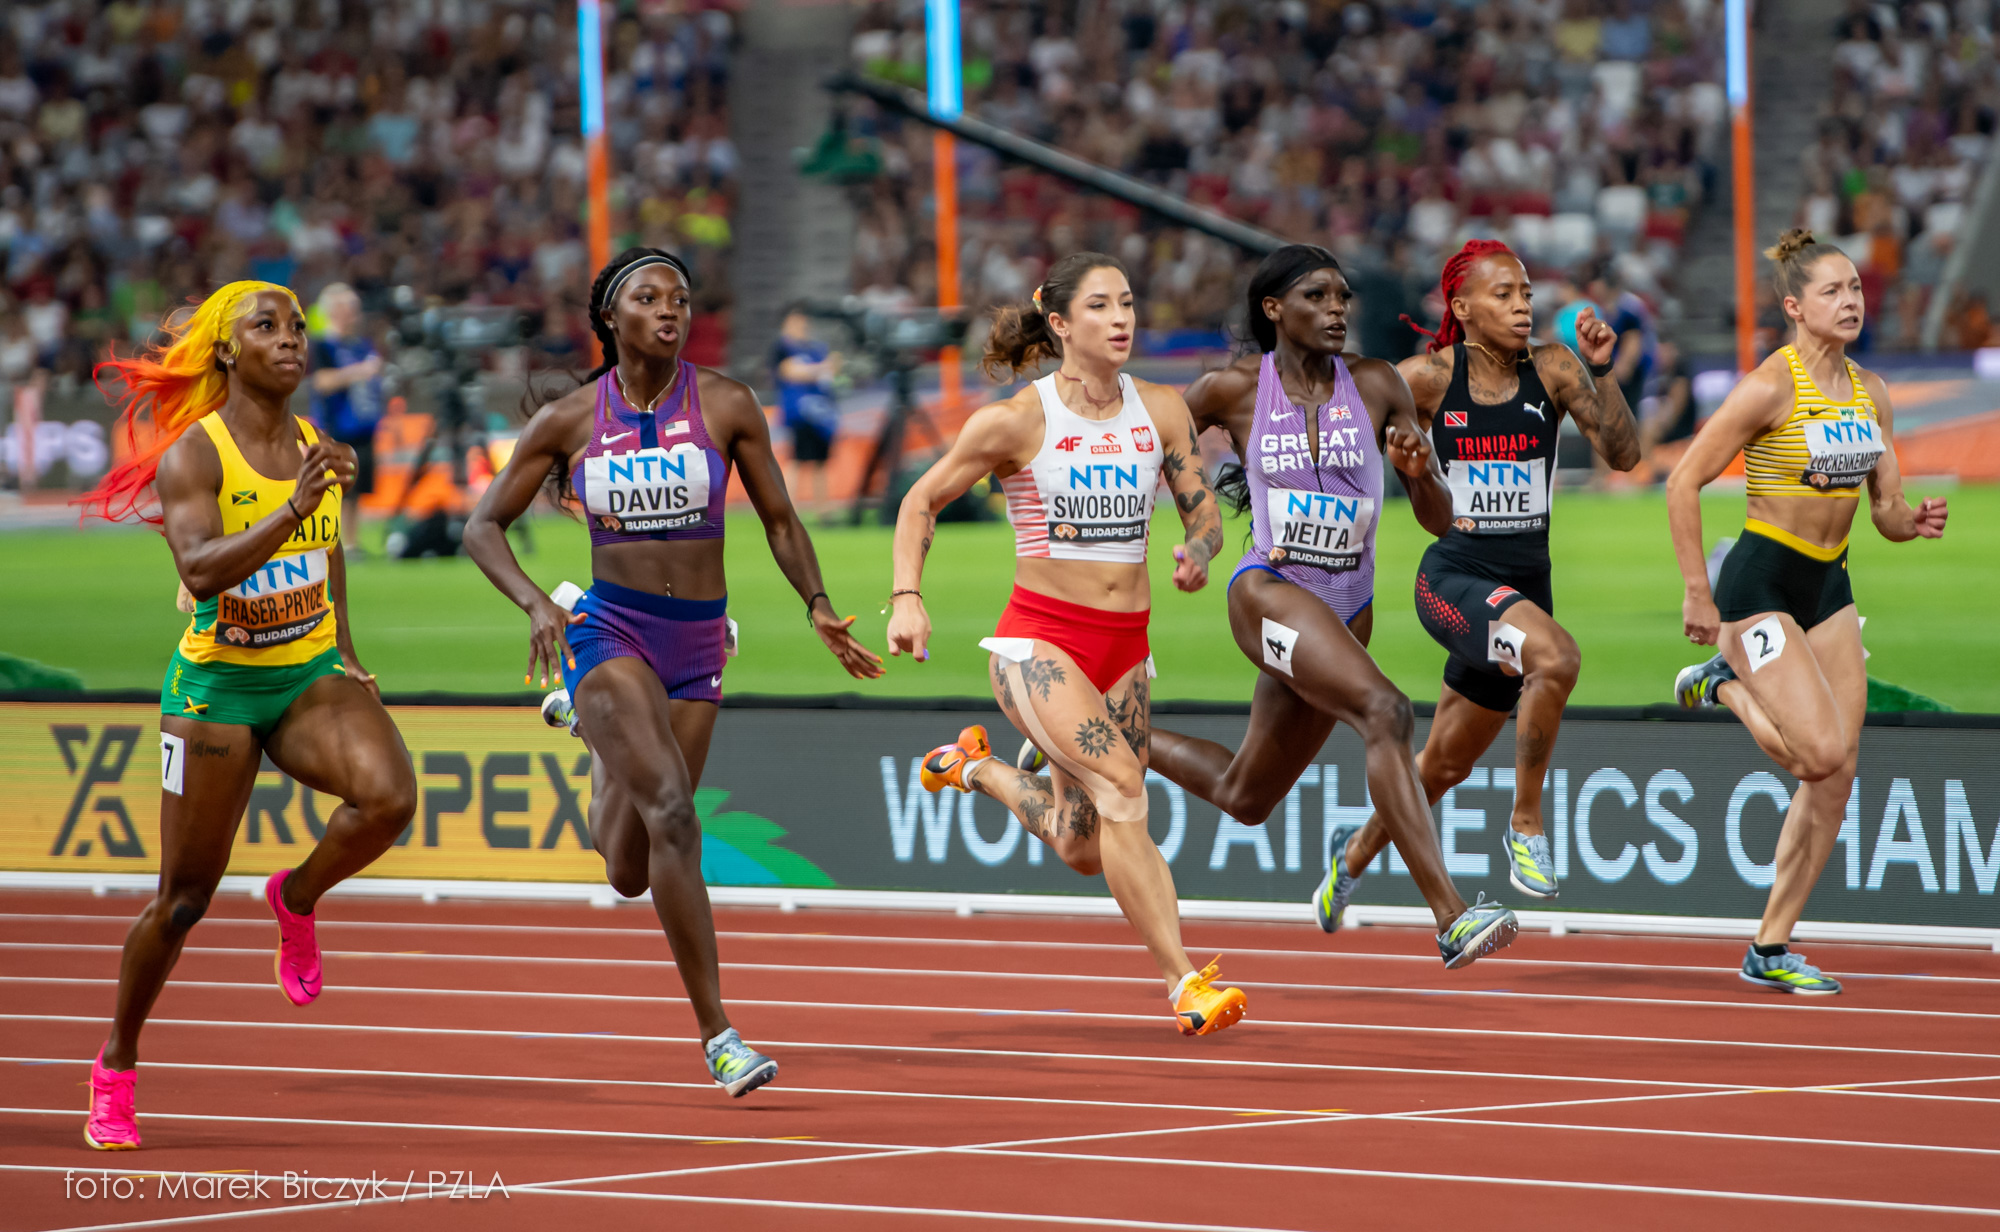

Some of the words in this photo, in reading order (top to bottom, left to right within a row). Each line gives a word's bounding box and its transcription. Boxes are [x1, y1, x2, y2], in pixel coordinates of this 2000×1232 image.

[1055, 436, 1083, 452] 4F
[1260, 427, 1359, 453] GREAT
[1822, 420, 1873, 444] NTN
[1092, 445, 1121, 454] ORLEN
[1260, 449, 1364, 474] BRITAIN
[608, 454, 686, 484] NTN
[1070, 464, 1137, 490] NTN
[1468, 463, 1531, 487] NTN
[608, 485, 689, 514] DAVIS
[1053, 493, 1146, 519] SWOBODA
[1288, 492, 1358, 524] NTN
[1470, 491, 1530, 513] AHYE
[244, 514, 339, 543] AICA
[625, 516, 687, 531] BUDAPEST
[1081, 528, 1133, 537] BUDAPEST
[1282, 521, 1349, 550] NEITA
[1479, 520, 1531, 529] BUDAPEST
[1289, 550, 1346, 567] BUDAPEST
[239, 554, 310, 596] NTN
[222, 583, 324, 626] FRASER-PRYCE
[1266, 637, 1287, 661] 4
[1494, 636, 1517, 658] 3
[1753, 628, 1775, 659] 2
[164, 742, 174, 780] 7
